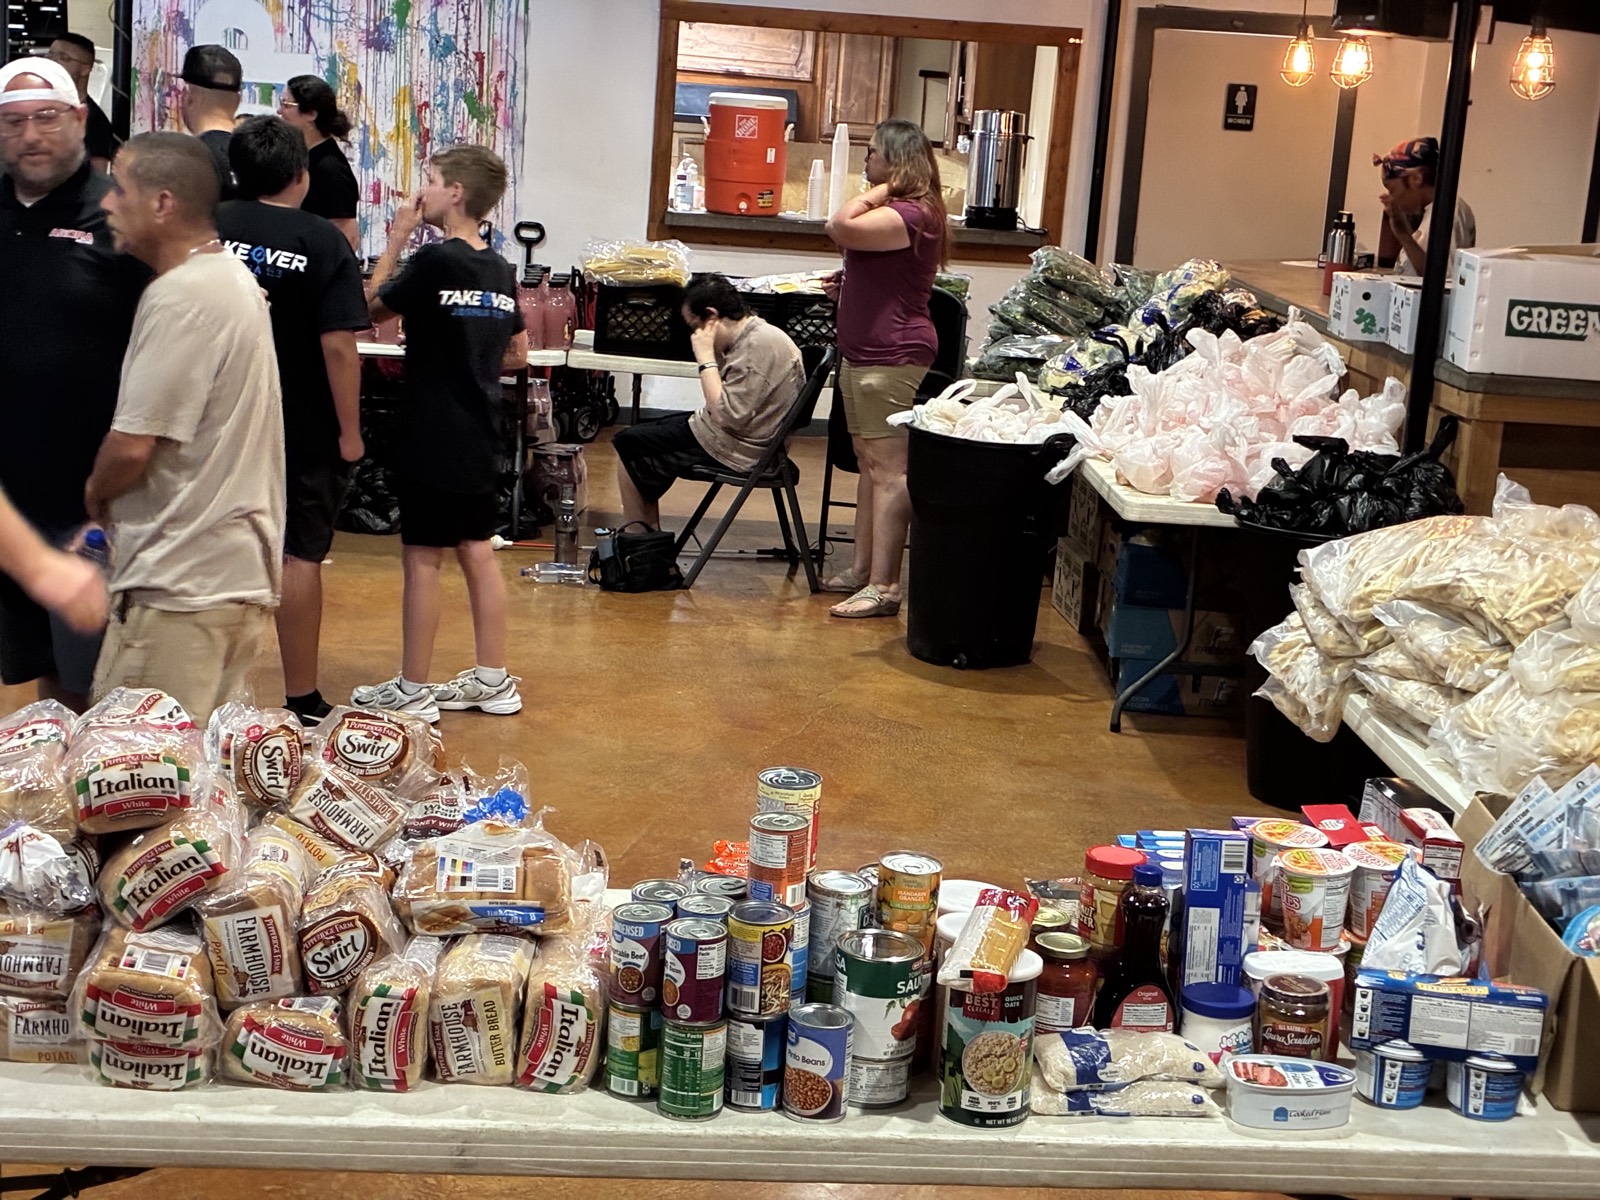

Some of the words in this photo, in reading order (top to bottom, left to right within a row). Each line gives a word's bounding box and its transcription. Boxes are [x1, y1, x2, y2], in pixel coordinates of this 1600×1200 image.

[224, 240, 308, 272] KEOVER
[381, 728, 398, 740] FARM
[342, 735, 391, 759] Swirl
[262, 745, 284, 797] Swirl
[93, 773, 175, 799] Italian
[122, 800, 150, 810] White
[308, 788, 375, 847] FARMHOUSE
[153, 843, 171, 857] FARM
[128, 855, 200, 908] Italian
[897, 890, 927, 898] MANDARIN
[165, 886, 190, 905] White
[334, 920, 356, 934] FARM
[236, 916, 271, 995] FARMHOUSE
[311, 935, 360, 975] Swirl
[630, 950, 646, 960] Beef
[130, 998, 158, 1012] White
[1138, 991, 1158, 999] Original
[484, 1001, 500, 1031] BREAD
[967, 1005, 996, 1016] CEREALS
[14, 1016, 70, 1036] FARMHO
[101, 1010, 183, 1044] Italian
[537, 1023, 549, 1048] White
[1263, 1028, 1285, 1043] Laura
[281, 1033, 308, 1049] White
[369, 1002, 393, 1076] Italian
[398, 1026, 407, 1053] White
[441, 1002, 476, 1076] FARMHOUSE
[490, 1034, 506, 1066] BUTTER
[544, 1004, 579, 1078] Italian
[105, 1053, 184, 1081] Italian
[251, 1042, 328, 1079] Italian
[788, 1049, 800, 1062] Pinto
[801, 1056, 826, 1067] Beans
[1289, 1109, 1315, 1118] Cooked
